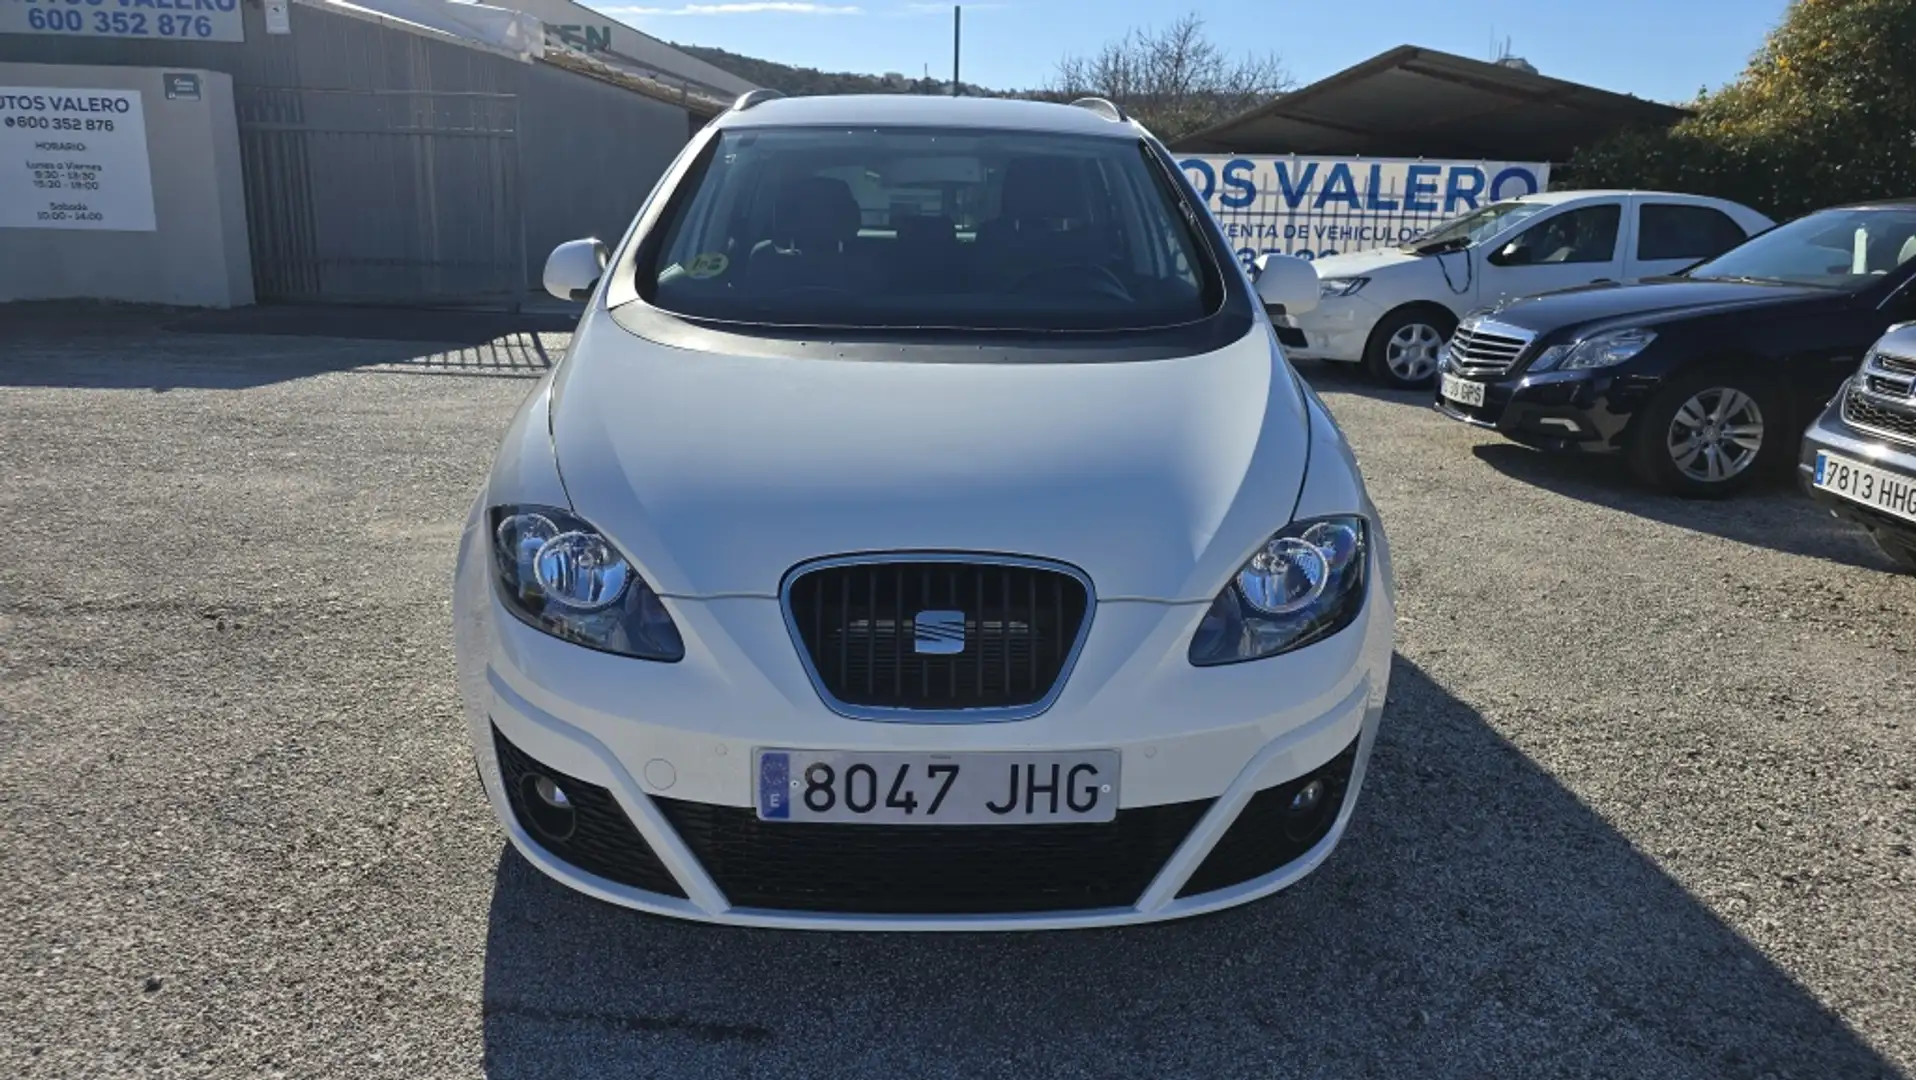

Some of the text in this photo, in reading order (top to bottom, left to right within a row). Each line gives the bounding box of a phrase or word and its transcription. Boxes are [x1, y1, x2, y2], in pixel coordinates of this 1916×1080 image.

[28, 8, 212, 37] 600 352 876
[48, 96, 130, 113] VALERO
[17, 116, 114, 132] 600 352 876
[1274, 160, 1537, 213] VALERO
[1283, 225, 1309, 240] DE
[1826, 461, 1916, 515] 7813 HHG
[803, 762, 1099, 815] 8047 JHG
[769, 793, 780, 808] E
